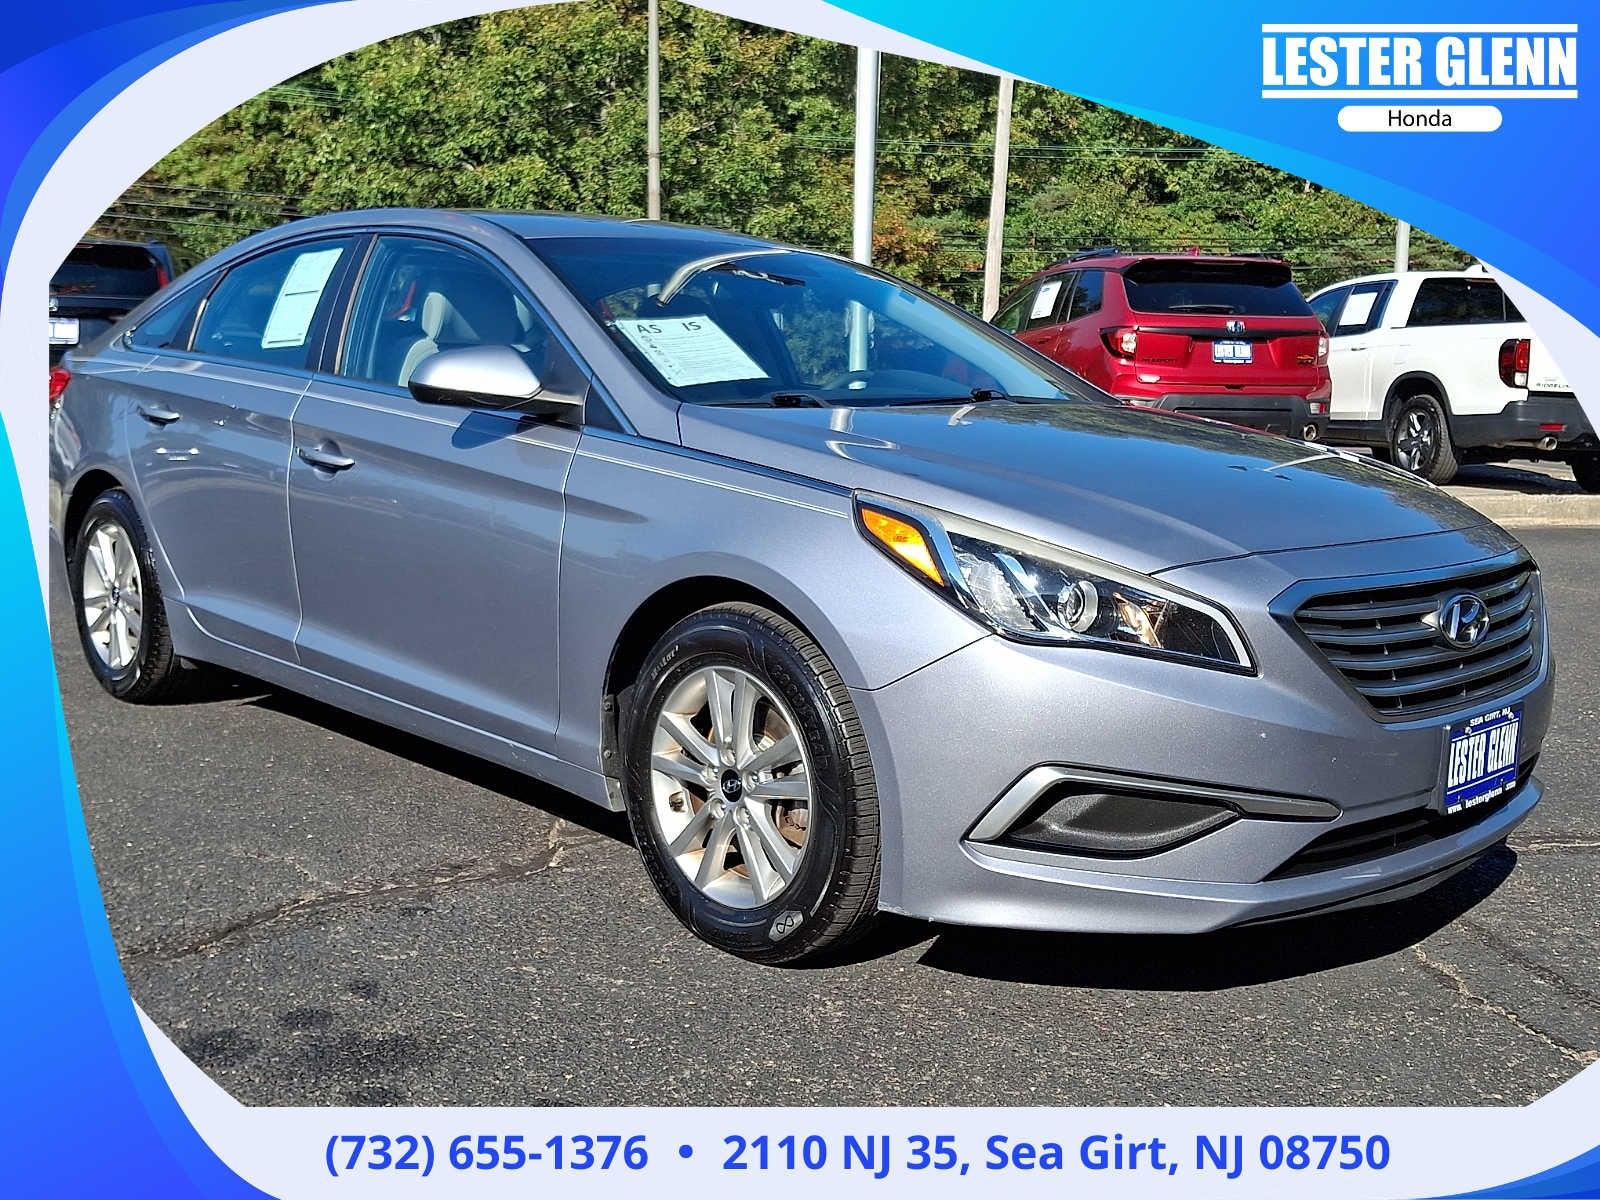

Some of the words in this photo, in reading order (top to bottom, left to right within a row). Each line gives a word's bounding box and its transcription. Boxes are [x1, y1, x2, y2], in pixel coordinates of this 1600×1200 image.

[636, 323, 662, 334] AS
[681, 321, 702, 331] IS
[1470, 716, 1483, 726] SEA
[1447, 732, 1487, 788] LESTER
[1487, 721, 1519, 774] GLENN
